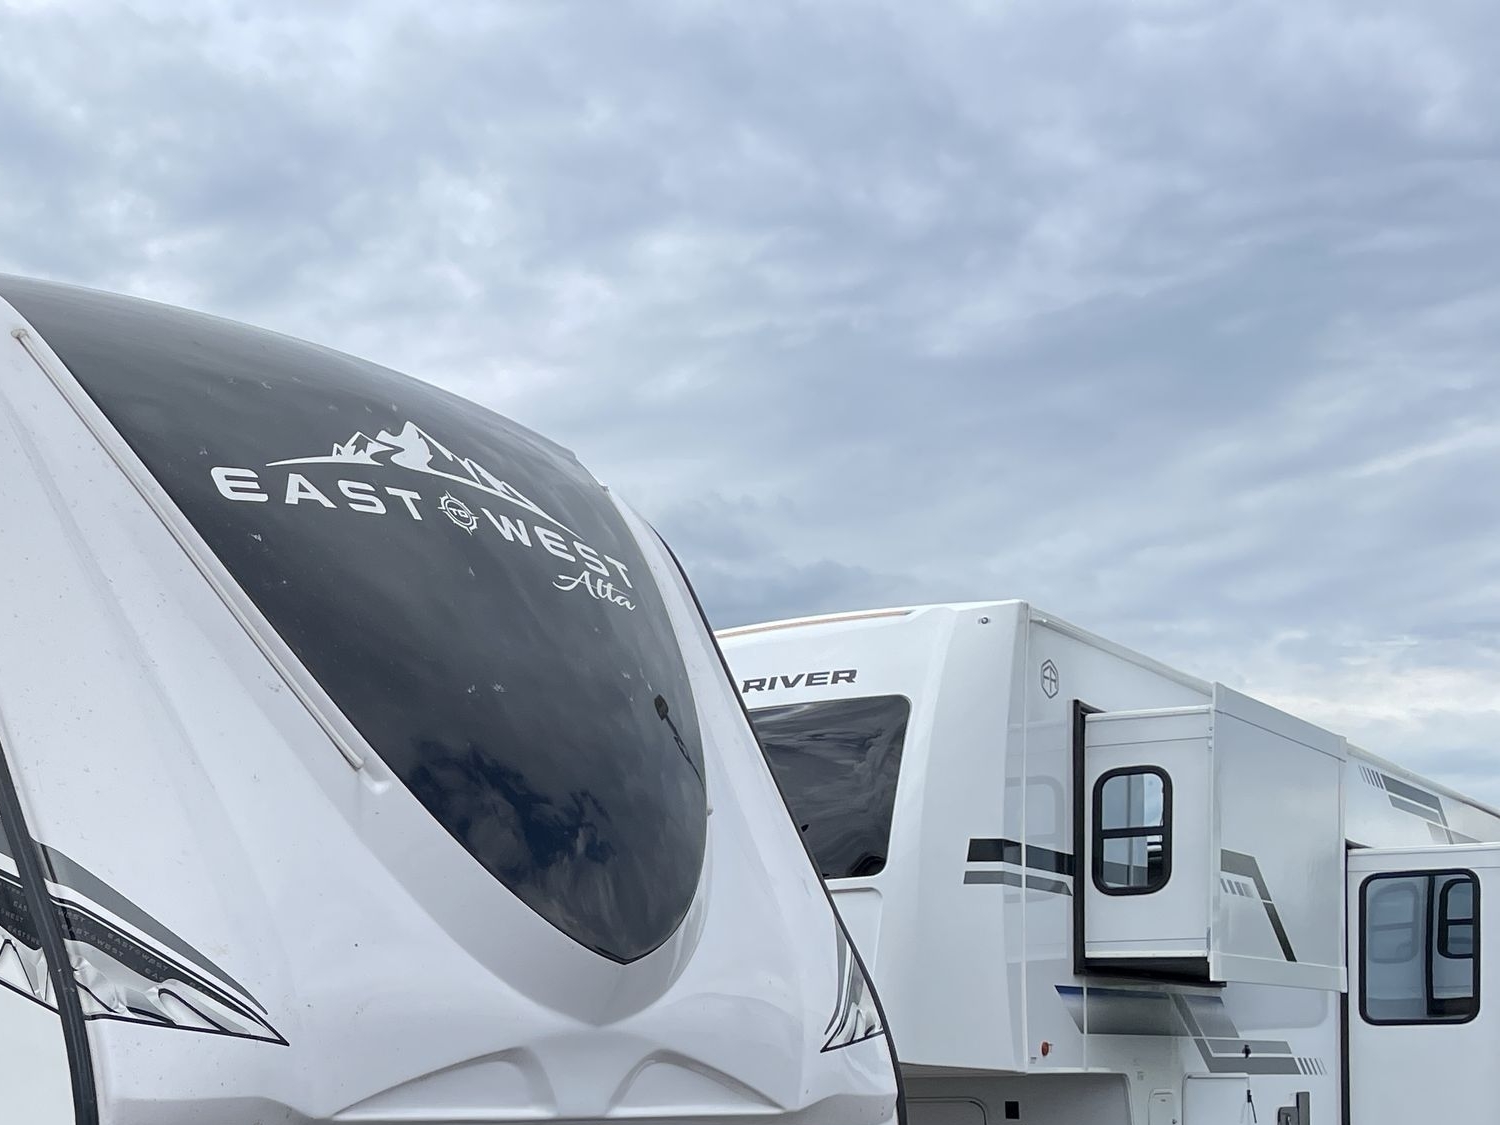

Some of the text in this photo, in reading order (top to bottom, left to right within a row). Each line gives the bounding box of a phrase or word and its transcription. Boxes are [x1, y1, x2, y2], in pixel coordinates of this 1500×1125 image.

[211, 466, 422, 521] EAST
[481, 507, 633, 589] WEST
[552, 570, 636, 611] Alta
[742, 669, 858, 694] RIVER
